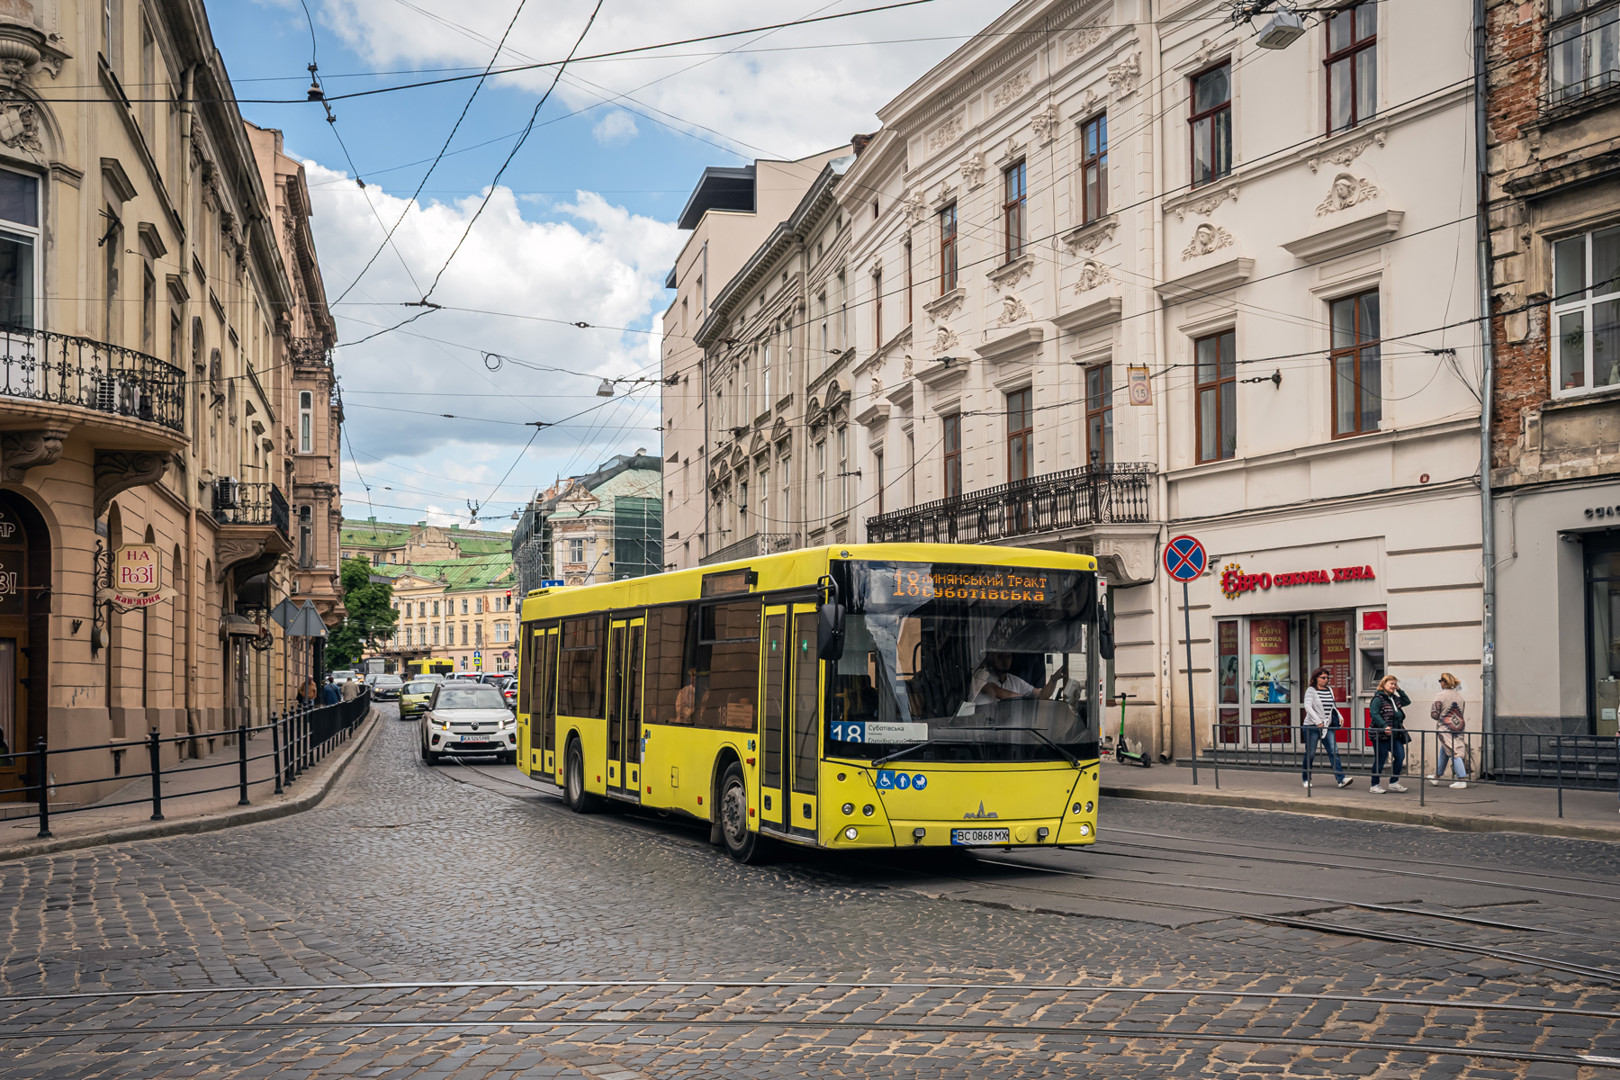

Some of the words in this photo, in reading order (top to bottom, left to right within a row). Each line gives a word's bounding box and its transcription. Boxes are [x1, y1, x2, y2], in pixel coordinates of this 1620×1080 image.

[1136, 388, 1146, 398] 15
[127, 550, 150, 560] НА
[1331, 565, 1376, 582] ХЕНД
[892, 570, 920, 597] 18
[1007, 574, 1047, 589] Тракт
[114, 594, 161, 606] кав'ярня
[833, 724, 862, 743] 18
[868, 724, 904, 732] Суботівська
[957, 831, 971, 841] BC
[972, 831, 994, 841] 0868
[994, 830, 1008, 841] MX
